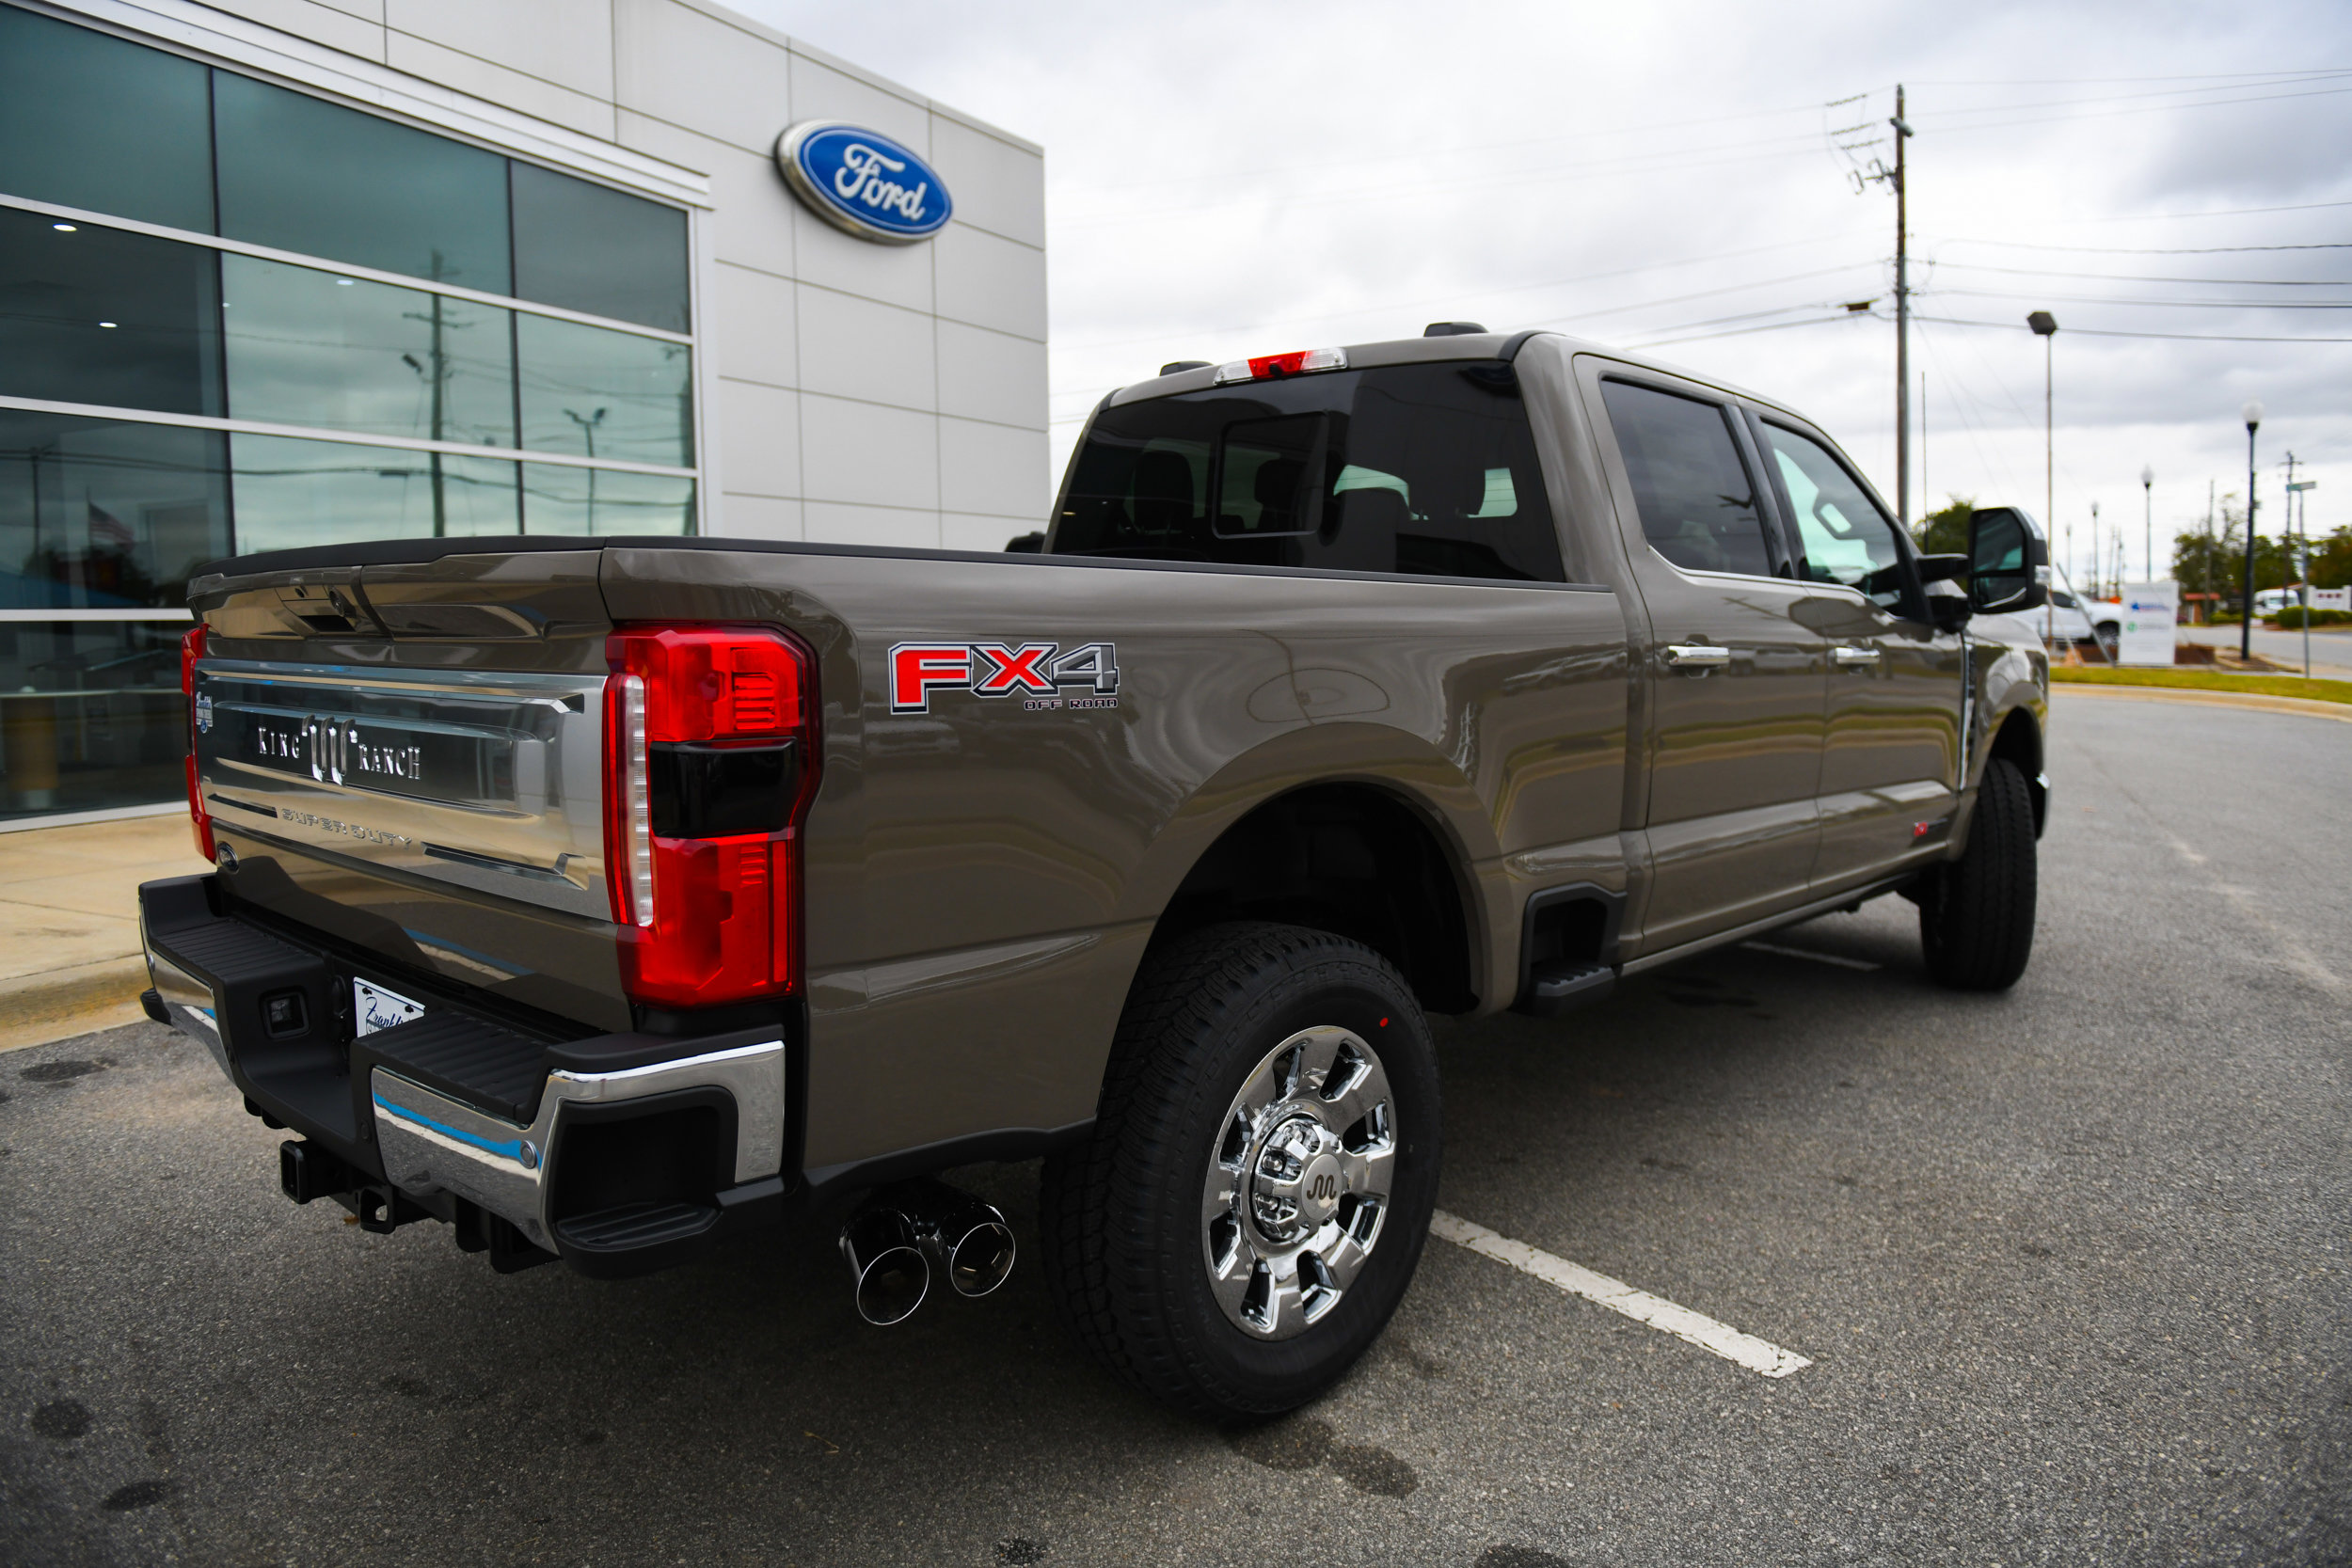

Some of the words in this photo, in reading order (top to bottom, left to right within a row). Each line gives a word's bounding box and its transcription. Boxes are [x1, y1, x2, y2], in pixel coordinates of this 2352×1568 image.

[834, 144, 927, 221] Ford
[888, 641, 1120, 715] FX4
[1025, 700, 1062, 710] OFF
[1069, 698, 1118, 709] ROAD
[258, 726, 300, 759] KING
[358, 744, 421, 780] RANCH
[282, 808, 347, 835] SUPER
[352, 824, 412, 850] DUTY
